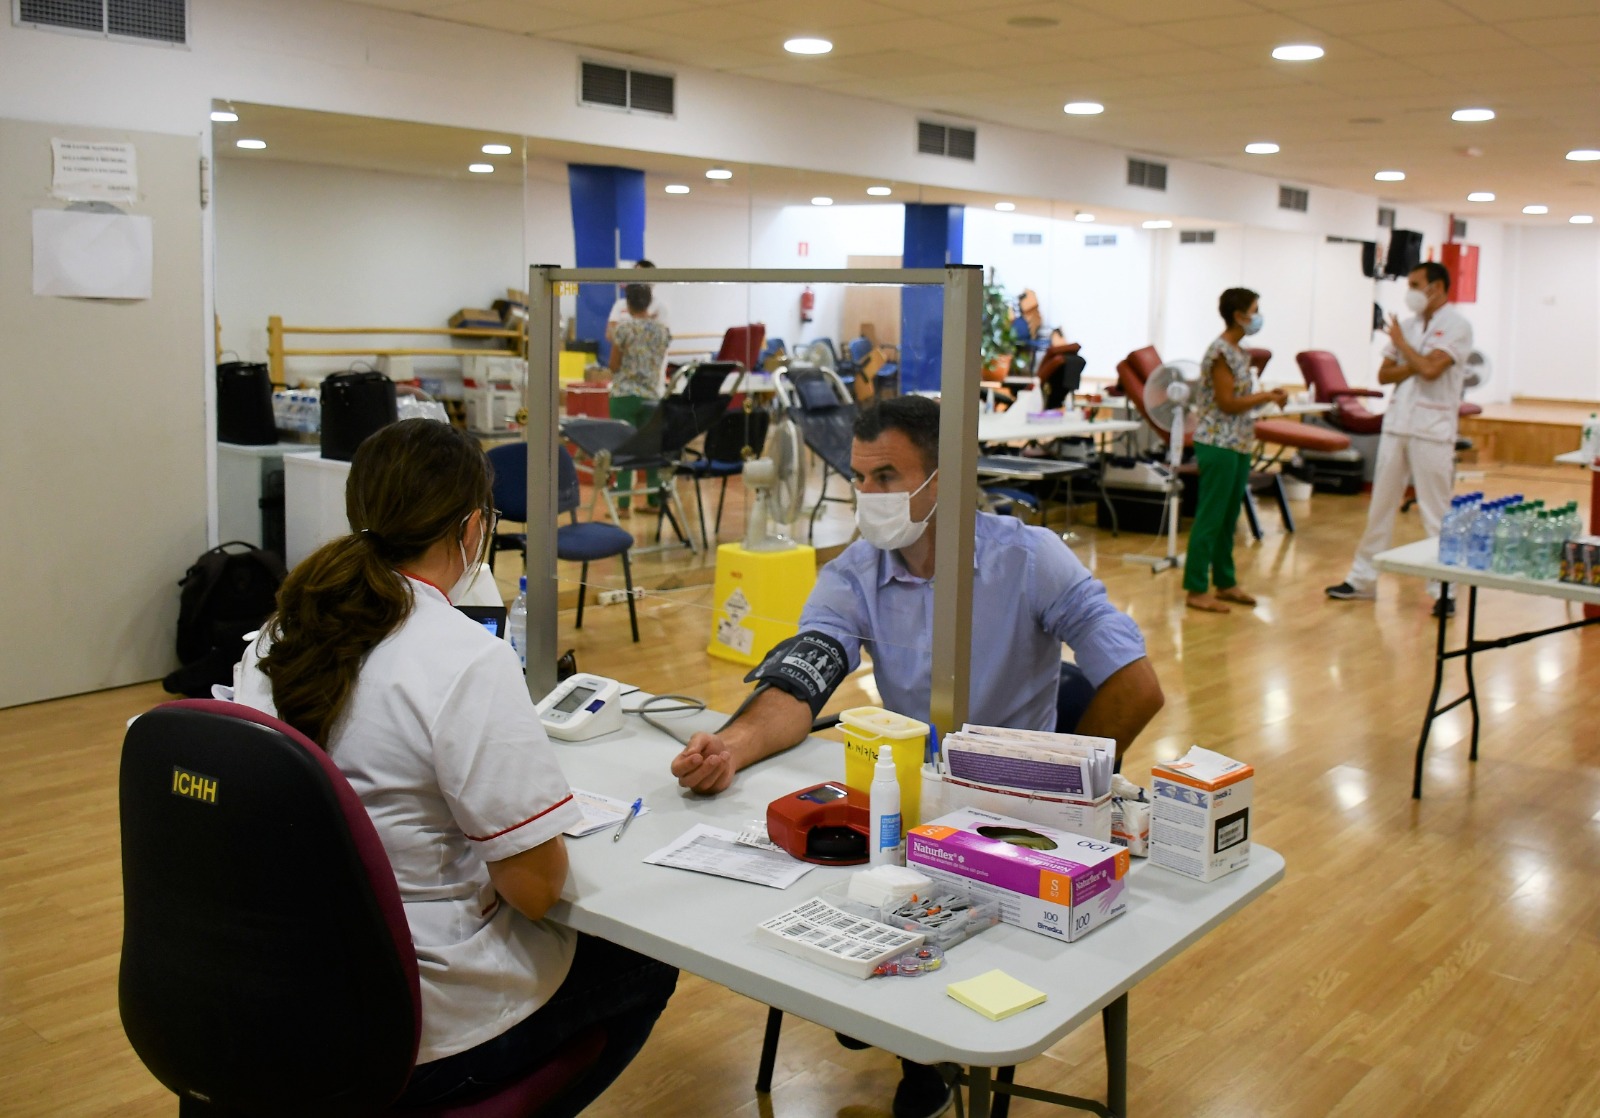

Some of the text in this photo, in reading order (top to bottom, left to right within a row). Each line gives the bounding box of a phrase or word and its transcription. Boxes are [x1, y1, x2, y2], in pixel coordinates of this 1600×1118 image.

[793, 659, 821, 681] ADULT
[173, 770, 217, 803] ICHH
[1077, 840, 1112, 853] 100
[1051, 879, 1059, 891] S
[1043, 911, 1059, 922] 100
[1075, 912, 1090, 931] 100
